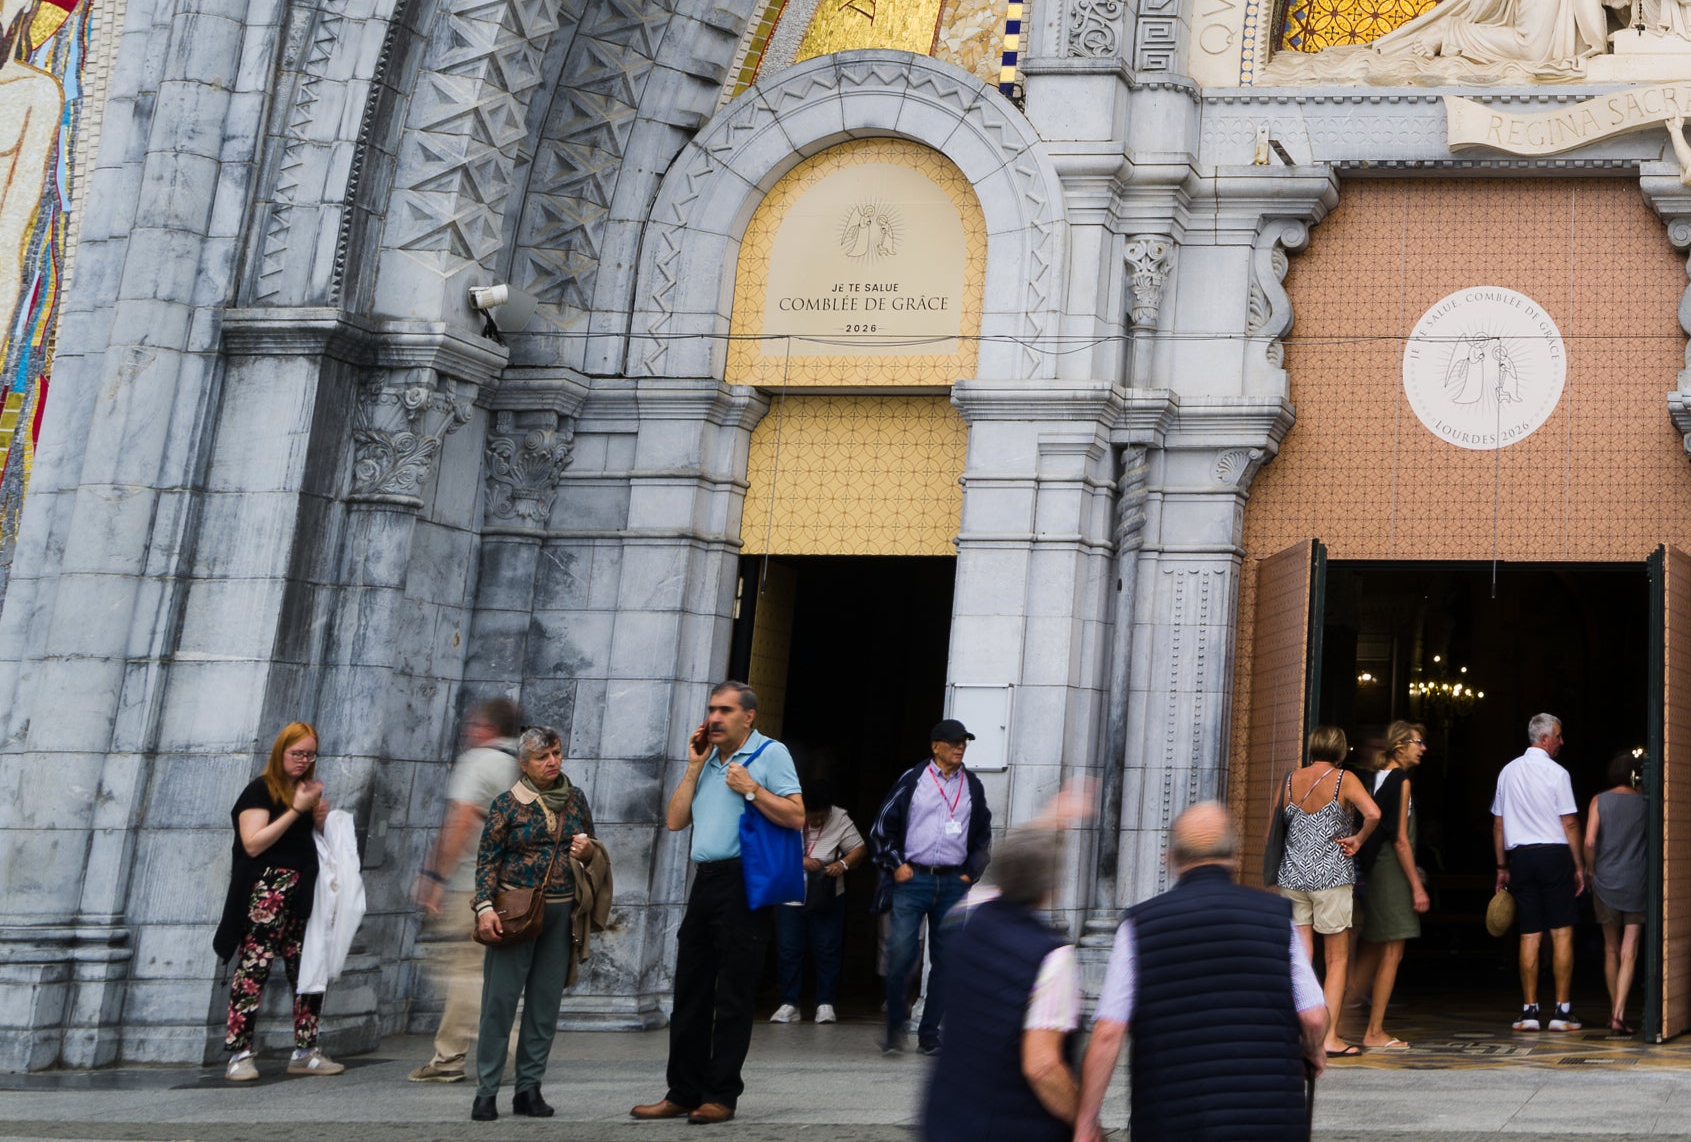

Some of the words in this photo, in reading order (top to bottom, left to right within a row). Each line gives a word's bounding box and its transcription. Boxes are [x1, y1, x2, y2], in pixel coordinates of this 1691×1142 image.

[1486, 108, 1602, 147] REGINA
[832, 283, 844, 293] JE
[848, 283, 860, 292] TE
[864, 283, 899, 292] SALUE
[779, 295, 858, 311] COMBLÉE
[865, 297, 886, 311] DE
[892, 295, 949, 311] GRÂCE
[1524, 306, 1540, 320] DE
[845, 324, 877, 333] 2026
[1435, 420, 1496, 444] LOURDES
[1502, 421, 1529, 441] 2026
